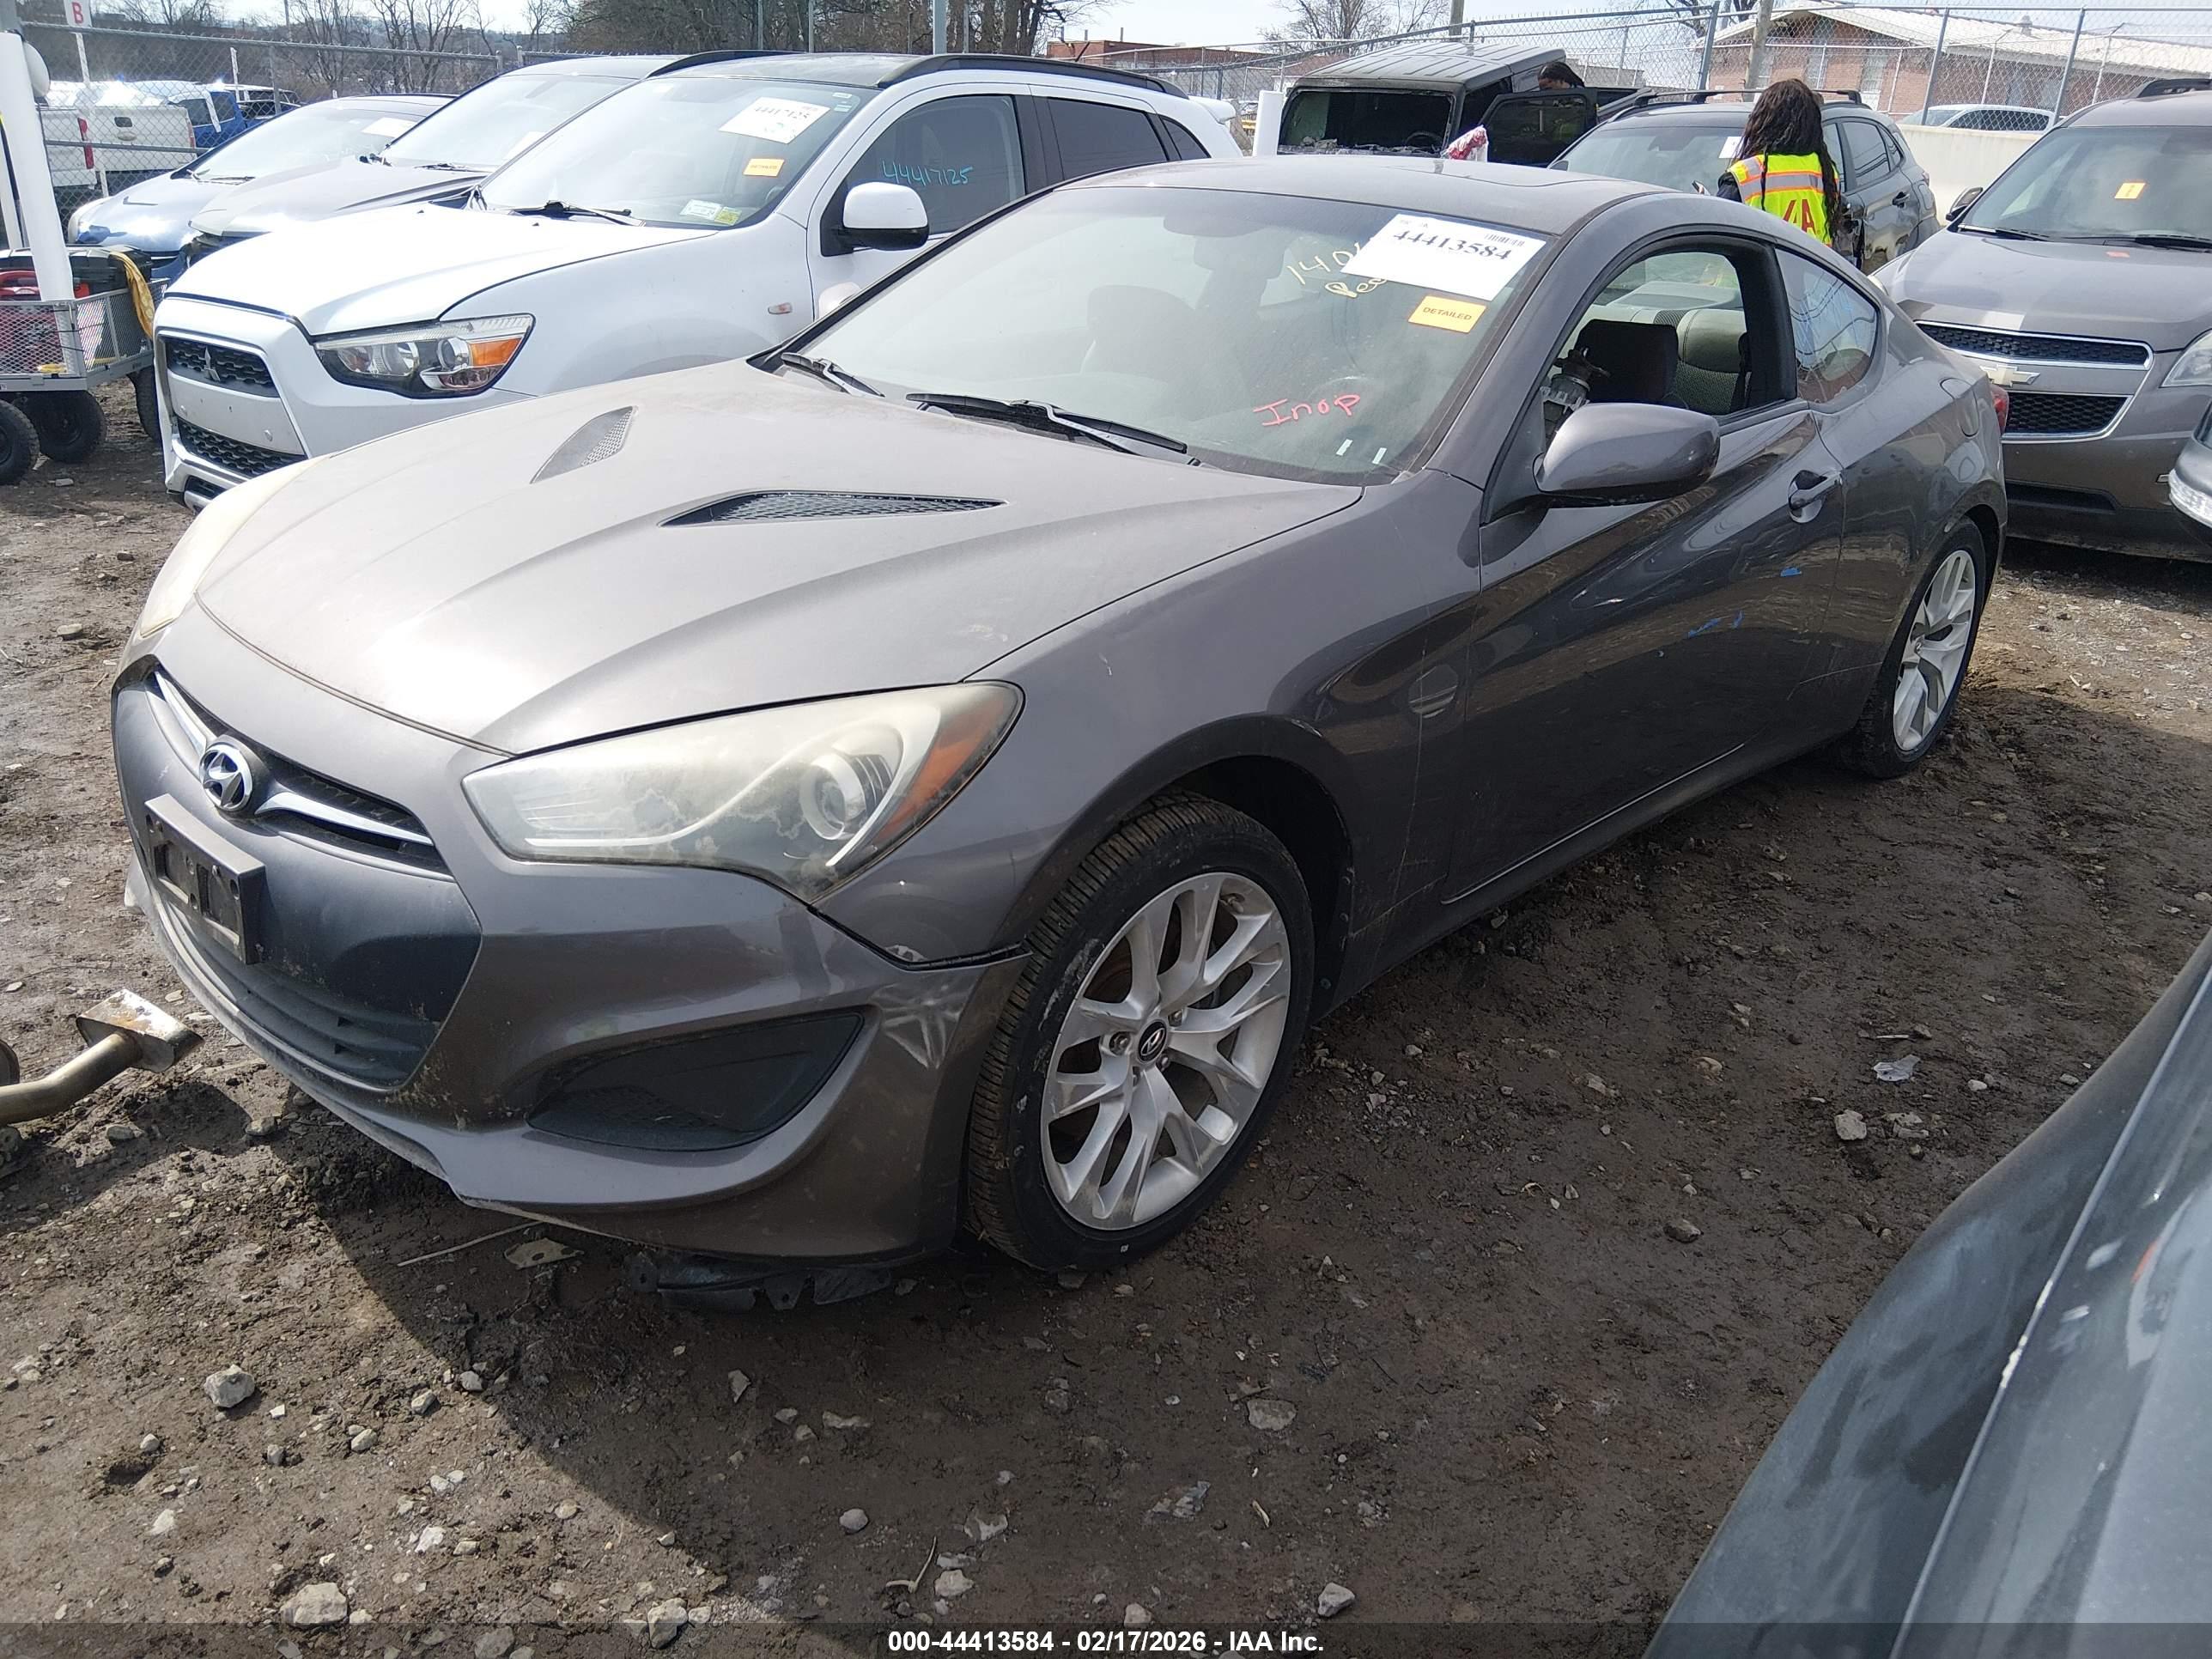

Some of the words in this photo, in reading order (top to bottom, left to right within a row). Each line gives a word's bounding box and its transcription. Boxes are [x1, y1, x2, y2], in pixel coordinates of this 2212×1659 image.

[72, 2, 83, 24] B
[882, 161, 974, 186] 44417125
[1393, 230, 1512, 260] 44413584
[1286, 241, 1361, 285] 140
[1423, 307, 1472, 321] DETAILED
